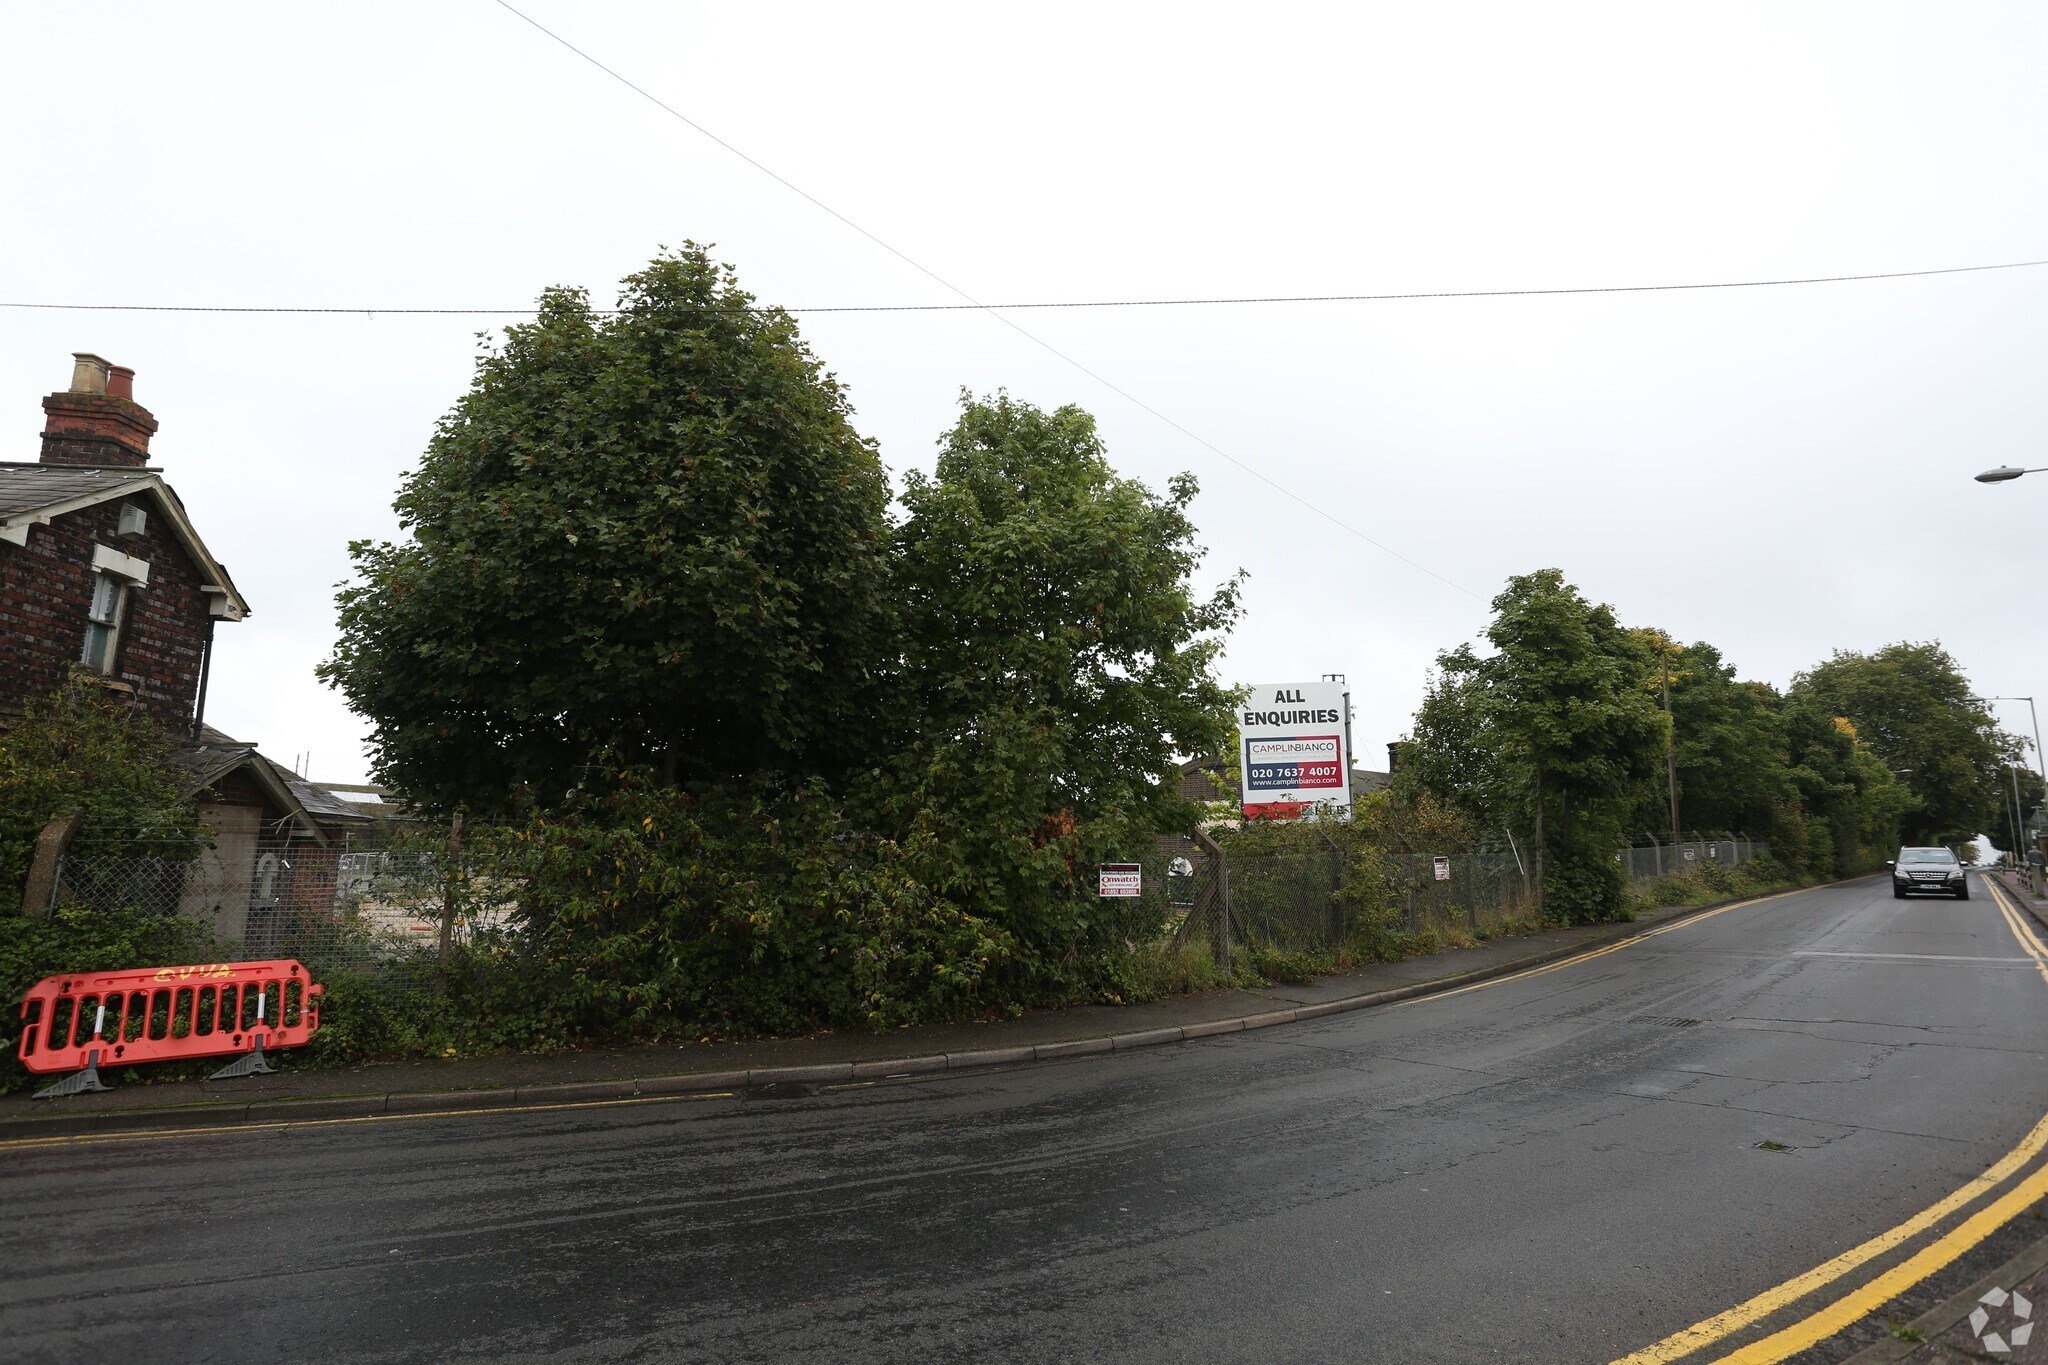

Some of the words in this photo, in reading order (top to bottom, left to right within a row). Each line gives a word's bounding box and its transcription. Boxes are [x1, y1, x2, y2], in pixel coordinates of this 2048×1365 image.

[1275, 690, 1305, 703] ALL
[1244, 709, 1339, 726] ENQUIRIES
[1252, 742, 1334, 753] CAMPLINBIANCO
[1252, 769, 1273, 778] 020
[1276, 767, 1305, 777] 7637
[1309, 766, 1337, 776] 4007
[1252, 777, 1337, 786] www.camplinbianco.com
[1101, 875, 1139, 883] Onwatch
